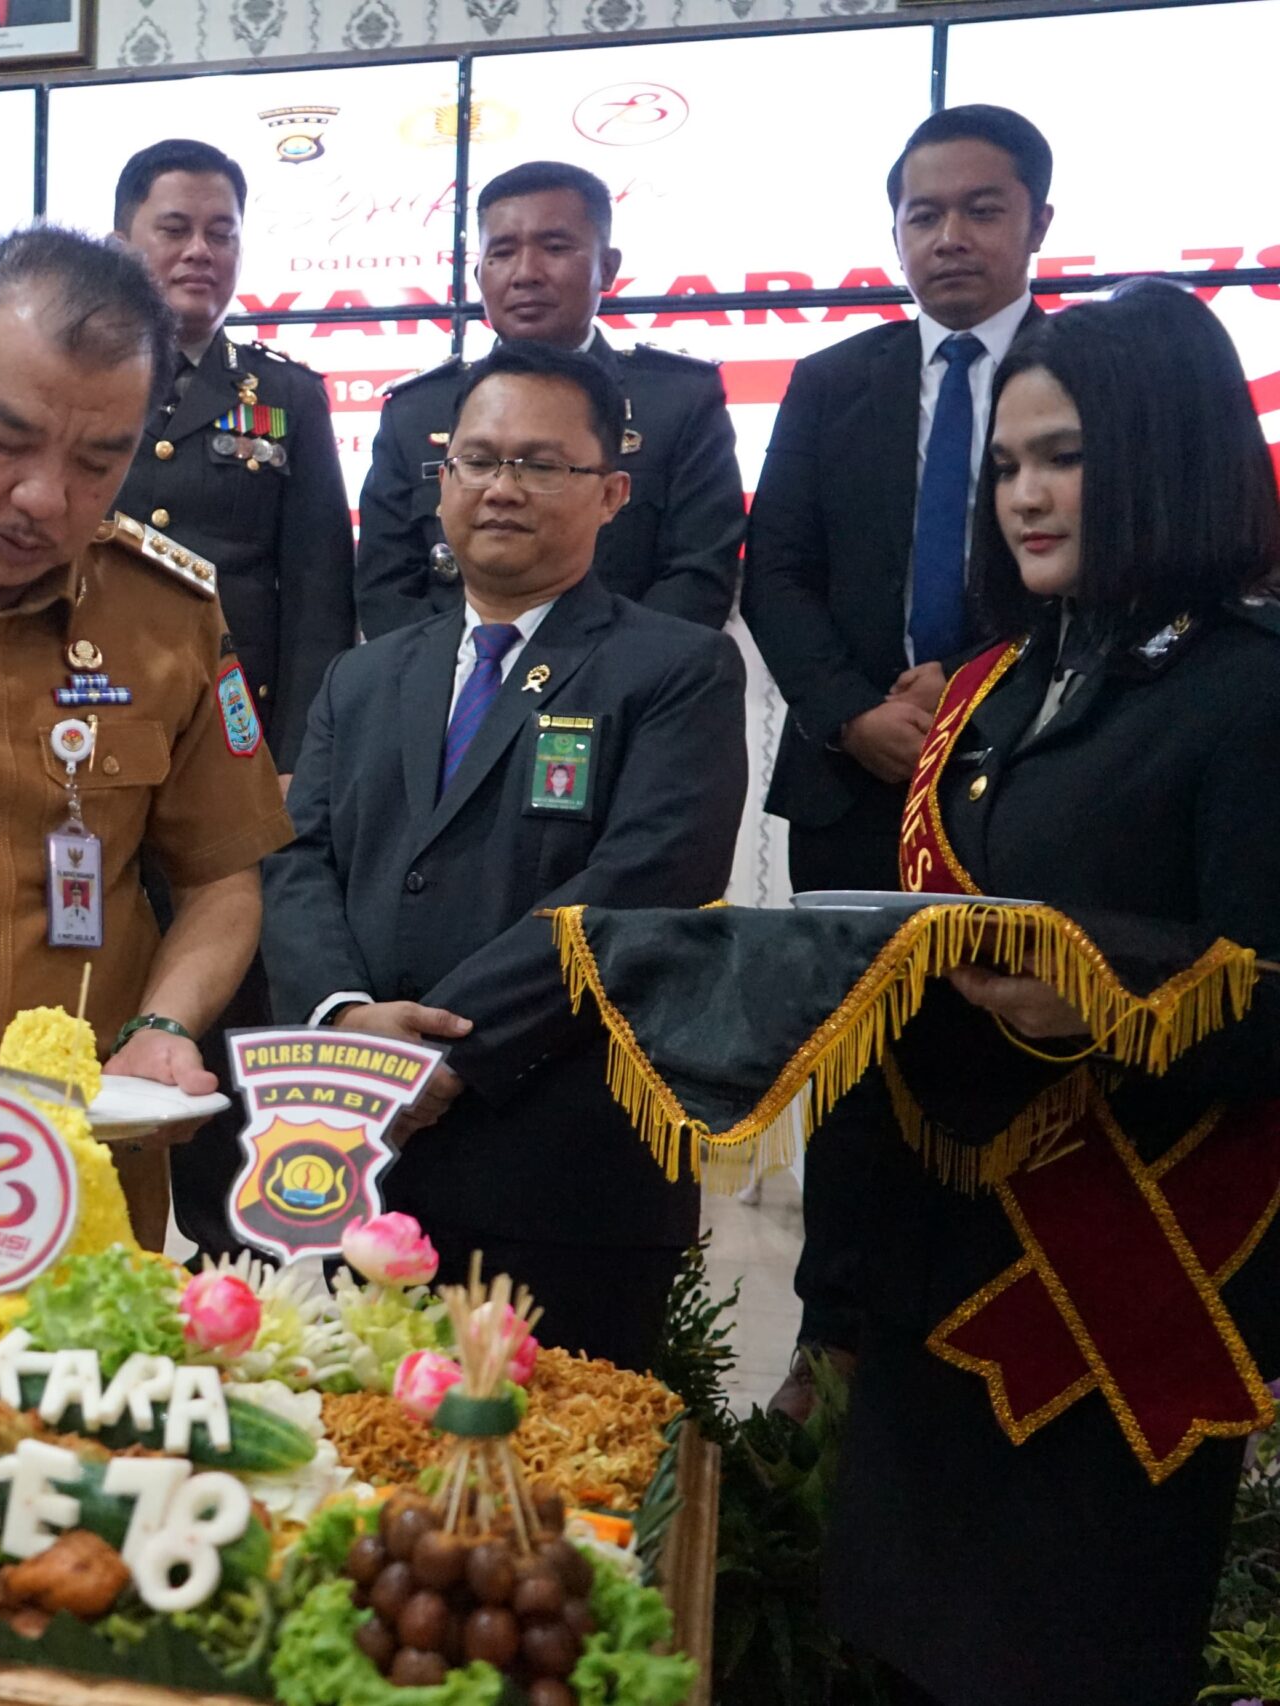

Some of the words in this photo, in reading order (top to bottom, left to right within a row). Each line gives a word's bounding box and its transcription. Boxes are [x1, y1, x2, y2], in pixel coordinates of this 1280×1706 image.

[290, 253, 422, 273] Dalam
[245, 1044, 314, 1069] POLRES
[318, 1045, 422, 1083] MERANGIN
[263, 1087, 381, 1114] JAMBI
[103, 1457, 253, 1612] 78
